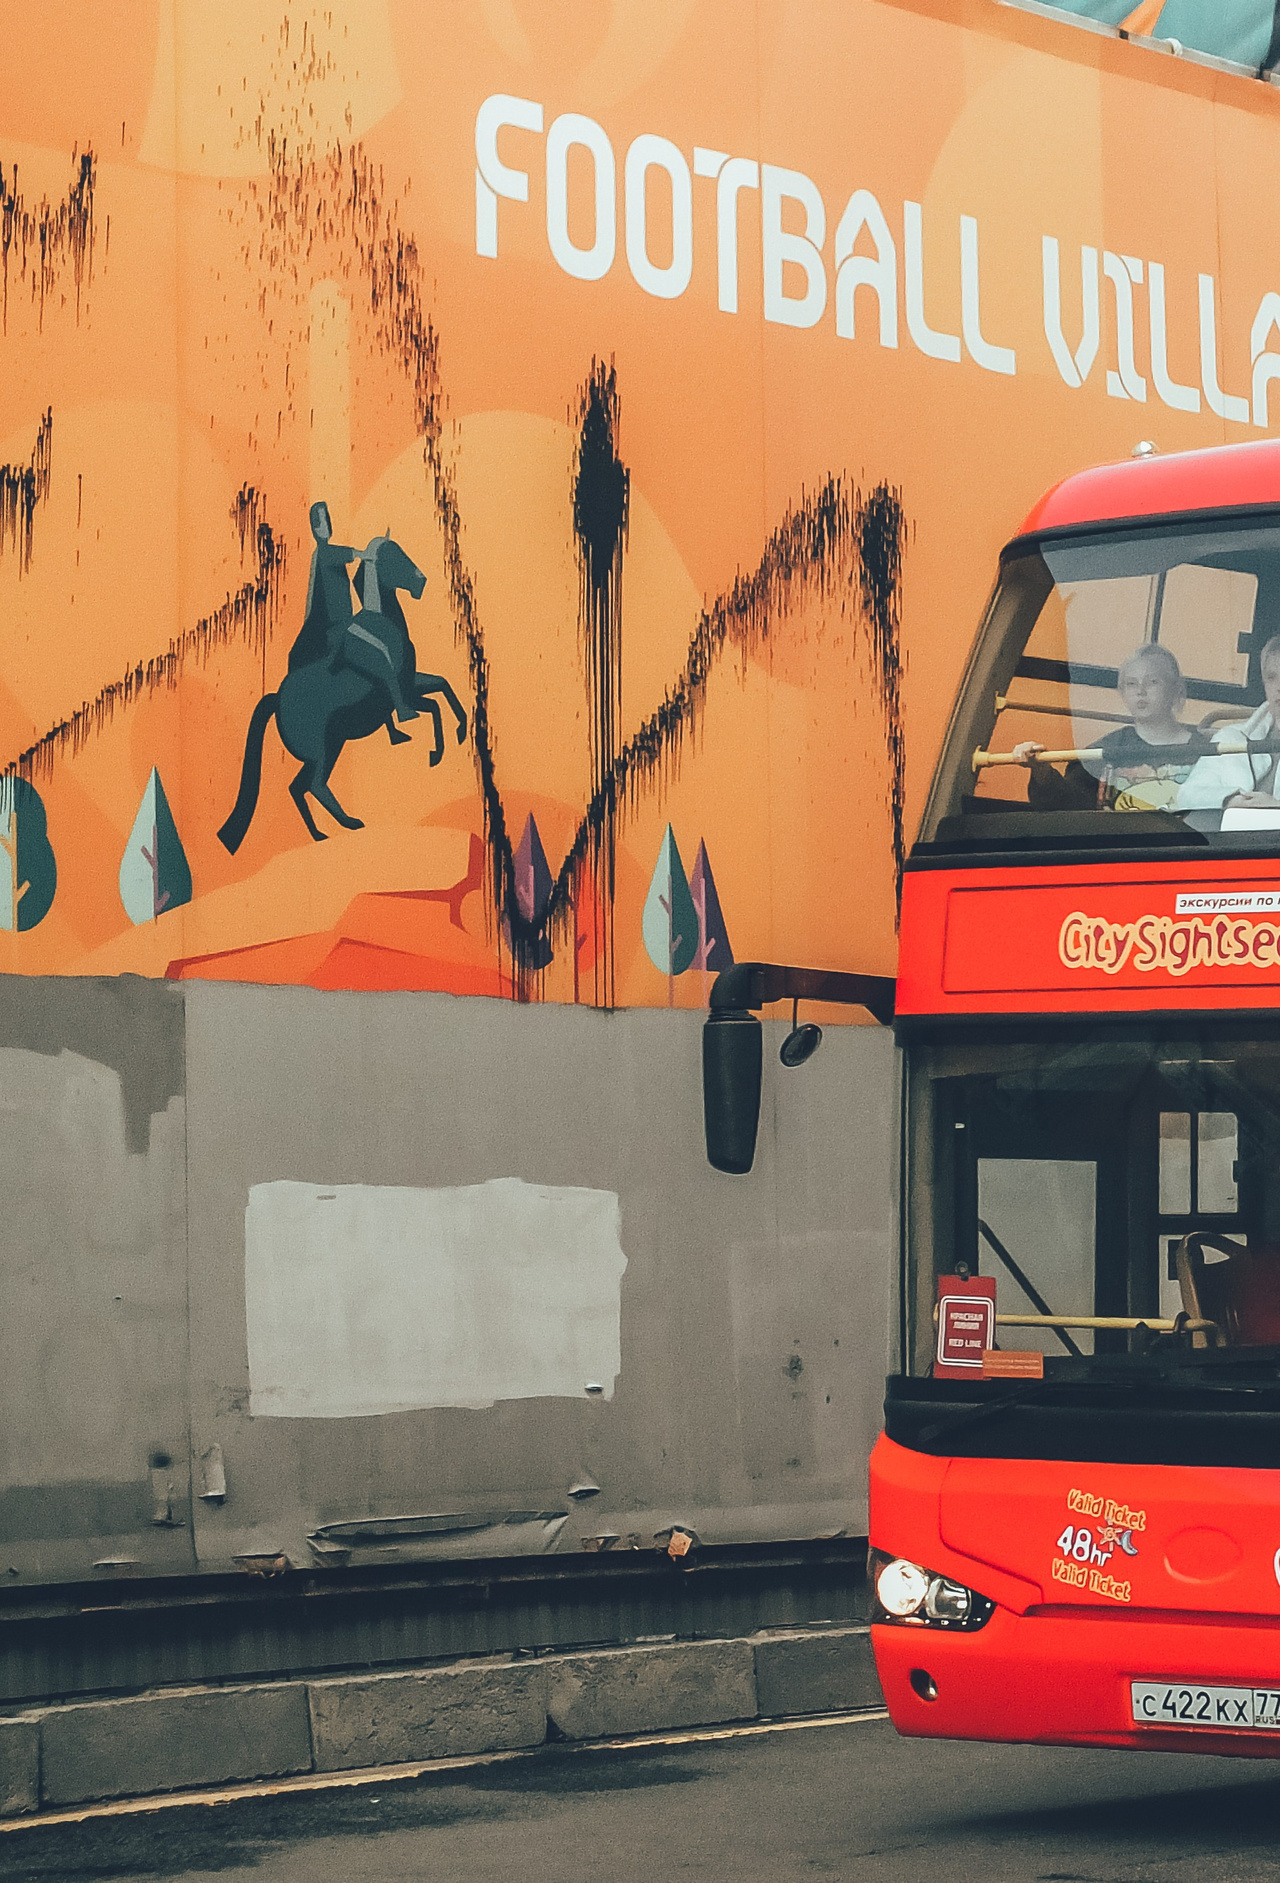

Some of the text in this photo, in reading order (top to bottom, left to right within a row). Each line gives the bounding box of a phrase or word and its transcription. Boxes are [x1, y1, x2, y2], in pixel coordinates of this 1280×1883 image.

[474, 92, 1016, 377] FOOTBALL
[1179, 896, 1253, 910] экскурсии
[1256, 896, 1274, 907] по
[1067, 1488, 1146, 1531] Valid Ticket
[1057, 1525, 1112, 1567] 48hr
[1052, 1557, 1131, 1602] Valid Ticket
[1255, 1716, 1276, 1725] RUS
